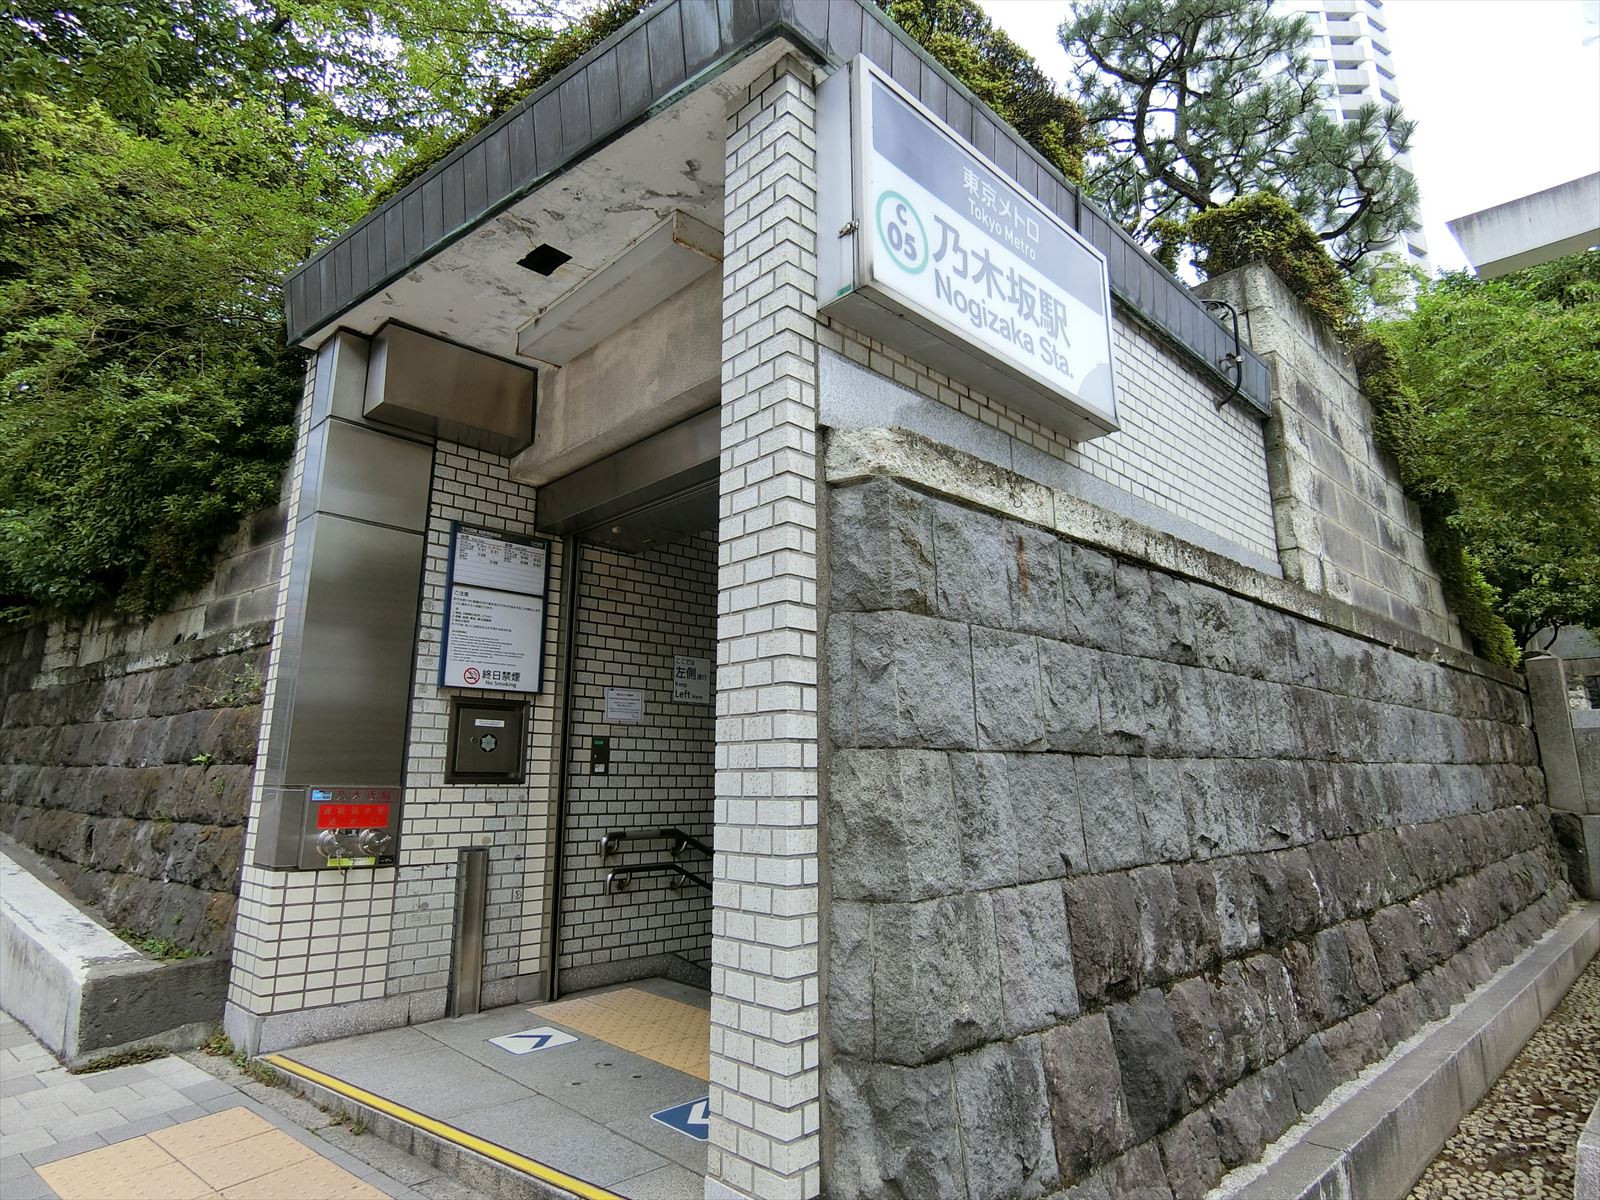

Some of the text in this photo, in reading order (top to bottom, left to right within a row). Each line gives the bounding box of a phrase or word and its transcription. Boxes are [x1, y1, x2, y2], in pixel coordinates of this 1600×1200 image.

[896, 203, 908, 227] C
[962, 166, 1040, 244] 東京メトロ
[968, 198, 1036, 261] Tokyo Metro
[887, 221, 918, 262] 05
[933, 214, 1071, 348] 乃木坂駅
[934, 268, 1074, 379] Nogizaka Sta.
[482, 669, 520, 682] 終日禁煙
[675, 689, 691, 699] Left
